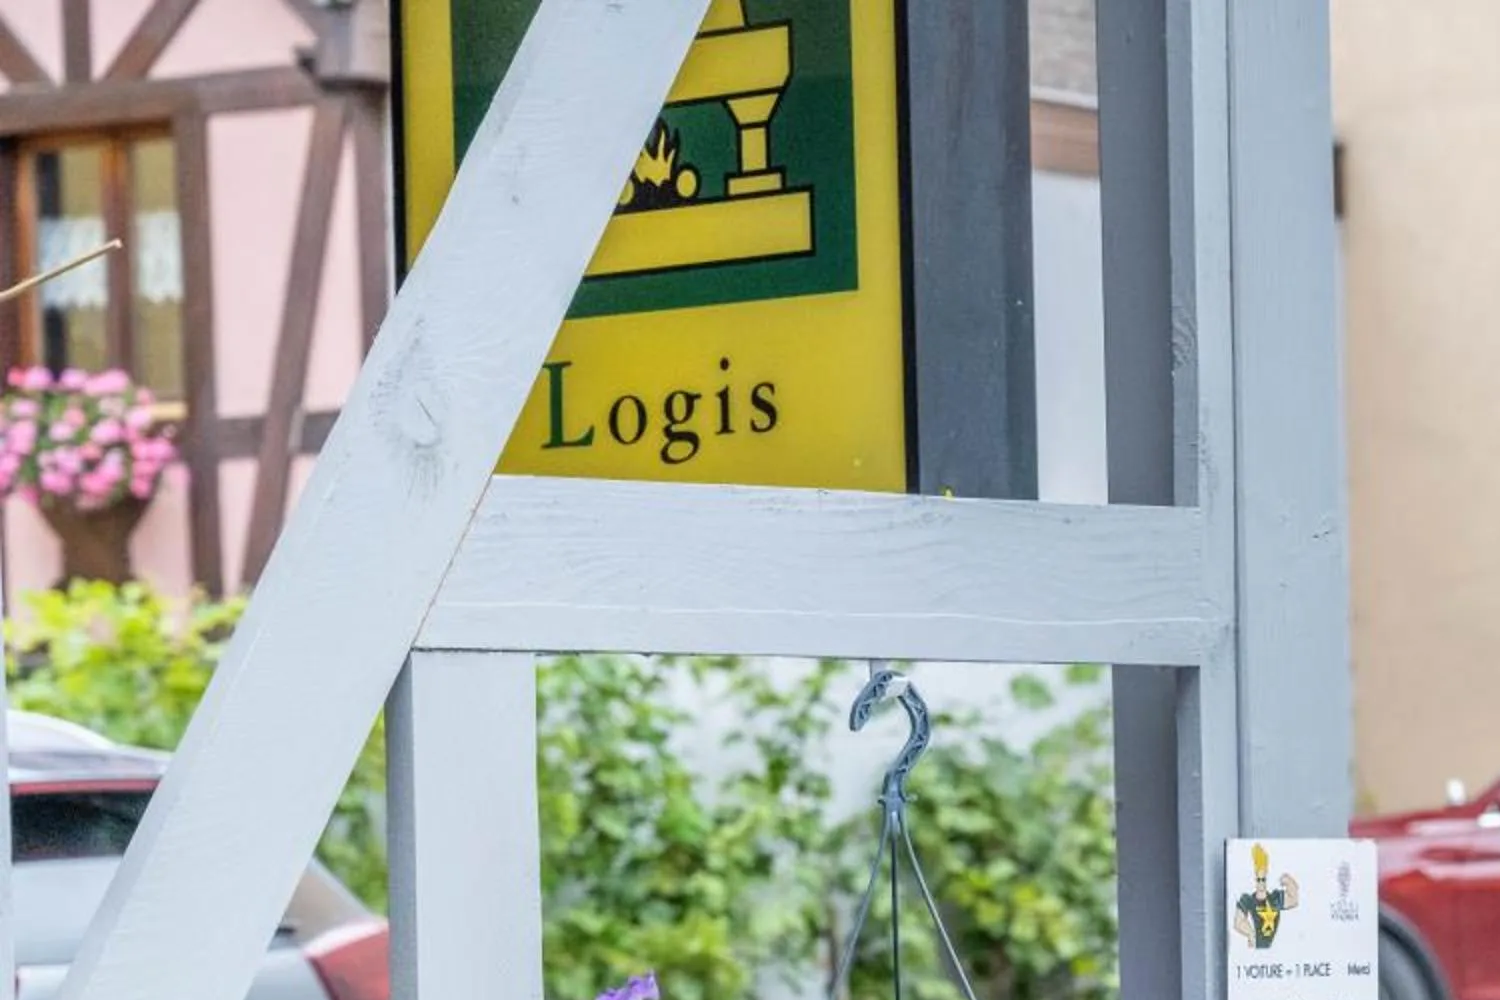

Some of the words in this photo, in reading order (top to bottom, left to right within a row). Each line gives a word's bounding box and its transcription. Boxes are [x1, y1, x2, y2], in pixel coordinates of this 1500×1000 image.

[541, 356, 778, 464] Logis
[1237, 965, 1241, 979] 1
[1243, 964, 1283, 979] VOITURE
[1303, 963, 1331, 977] PLACE
[1347, 962, 1371, 976] Merci
